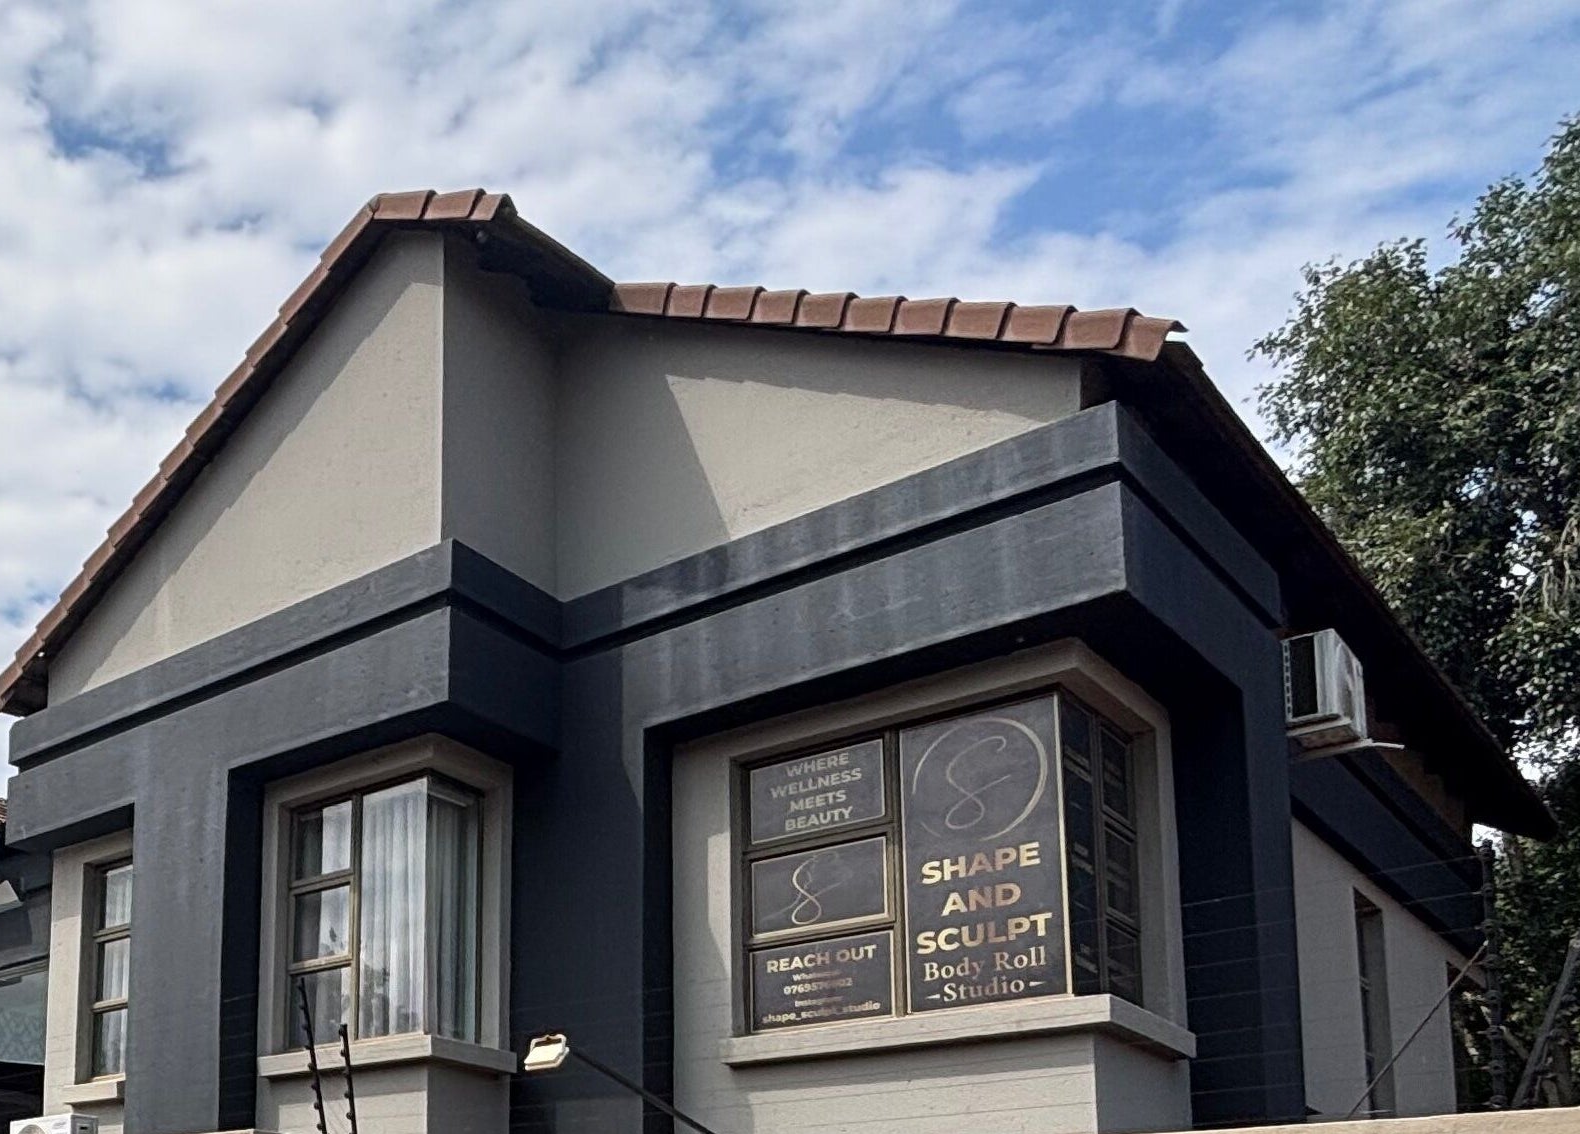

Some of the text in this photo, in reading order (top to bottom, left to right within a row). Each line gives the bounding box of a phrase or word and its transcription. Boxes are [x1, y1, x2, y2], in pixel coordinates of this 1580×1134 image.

[786, 752, 849, 777] WHERE
[770, 768, 862, 798] WELLNESS
[789, 790, 847, 812] MEETS
[785, 806, 853, 831] BEAUTY
[921, 841, 1041, 885] SHAPE
[941, 882, 1021, 917] AND
[917, 912, 1053, 954] SCULPT
[766, 944, 878, 973] REACH OUT
[924, 957, 985, 982] Body
[993, 946, 1047, 971] Roll
[943, 976, 1025, 1002] Studio
